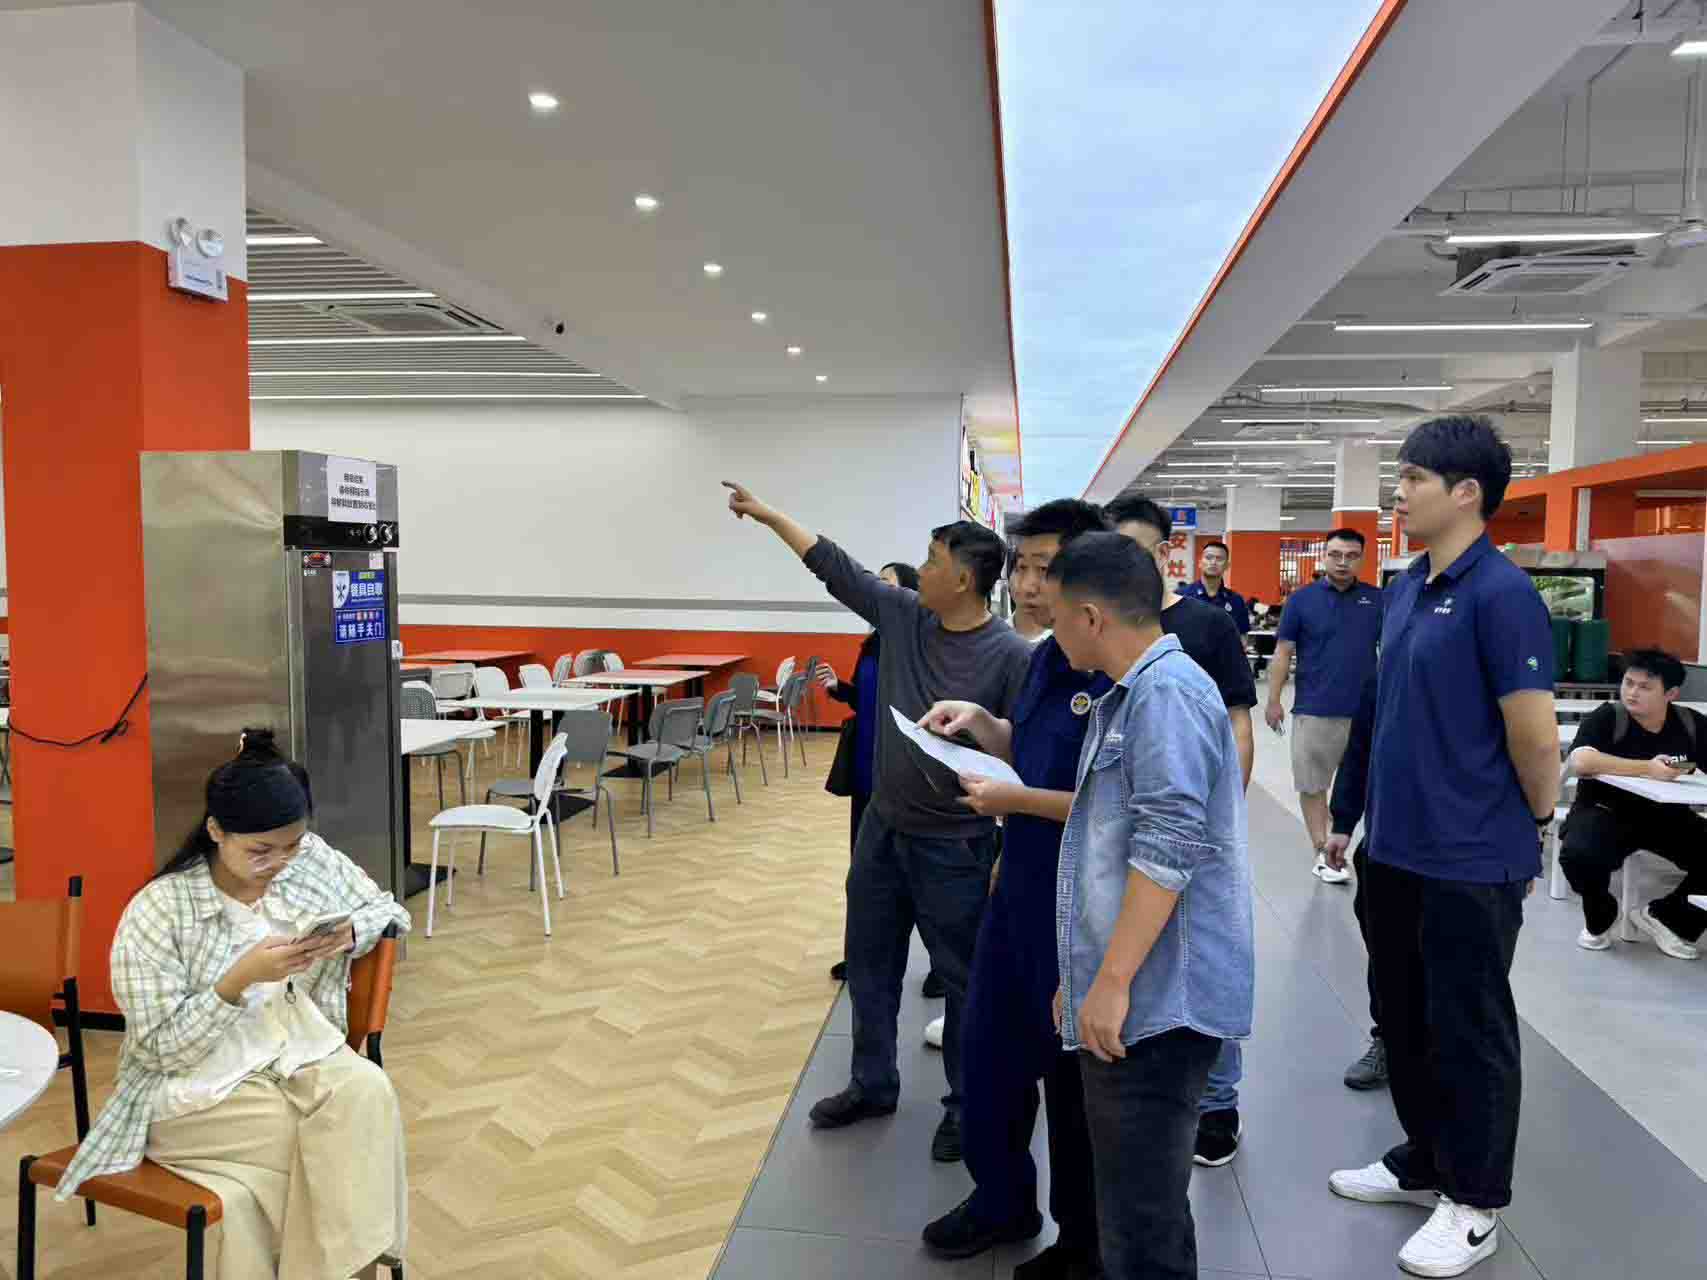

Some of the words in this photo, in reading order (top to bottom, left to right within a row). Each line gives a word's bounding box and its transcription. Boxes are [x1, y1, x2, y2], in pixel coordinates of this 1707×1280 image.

[338, 622, 382, 640] 请随手关门
